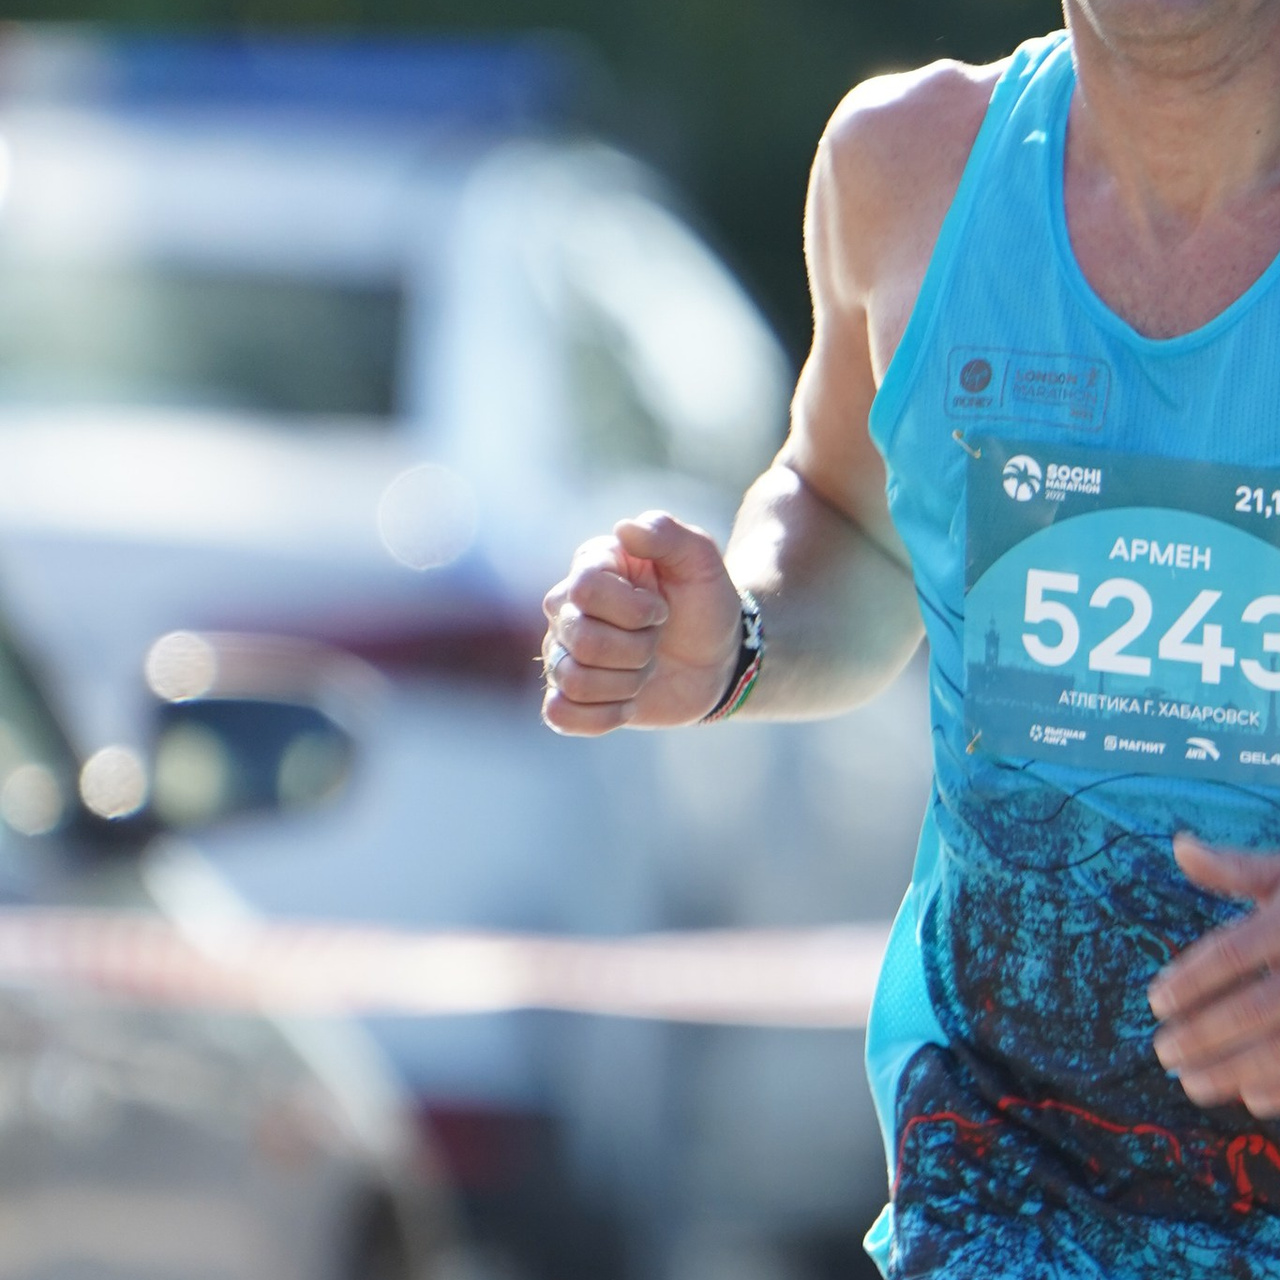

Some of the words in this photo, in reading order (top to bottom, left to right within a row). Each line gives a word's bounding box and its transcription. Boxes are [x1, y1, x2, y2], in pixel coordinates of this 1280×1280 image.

[1015, 369, 1078, 386] LONDON
[1012, 384, 1098, 407] MARATHON
[1046, 463, 1102, 484] SOCHI
[1045, 479, 1101, 495] MARATHON
[1109, 536, 1212, 570] АРМЕН
[1058, 689, 1141, 714] АТЛЕТИКА
[1158, 701, 1260, 727] ХАБАРОВСК
[1118, 738, 1166, 754] МАГНИТ
